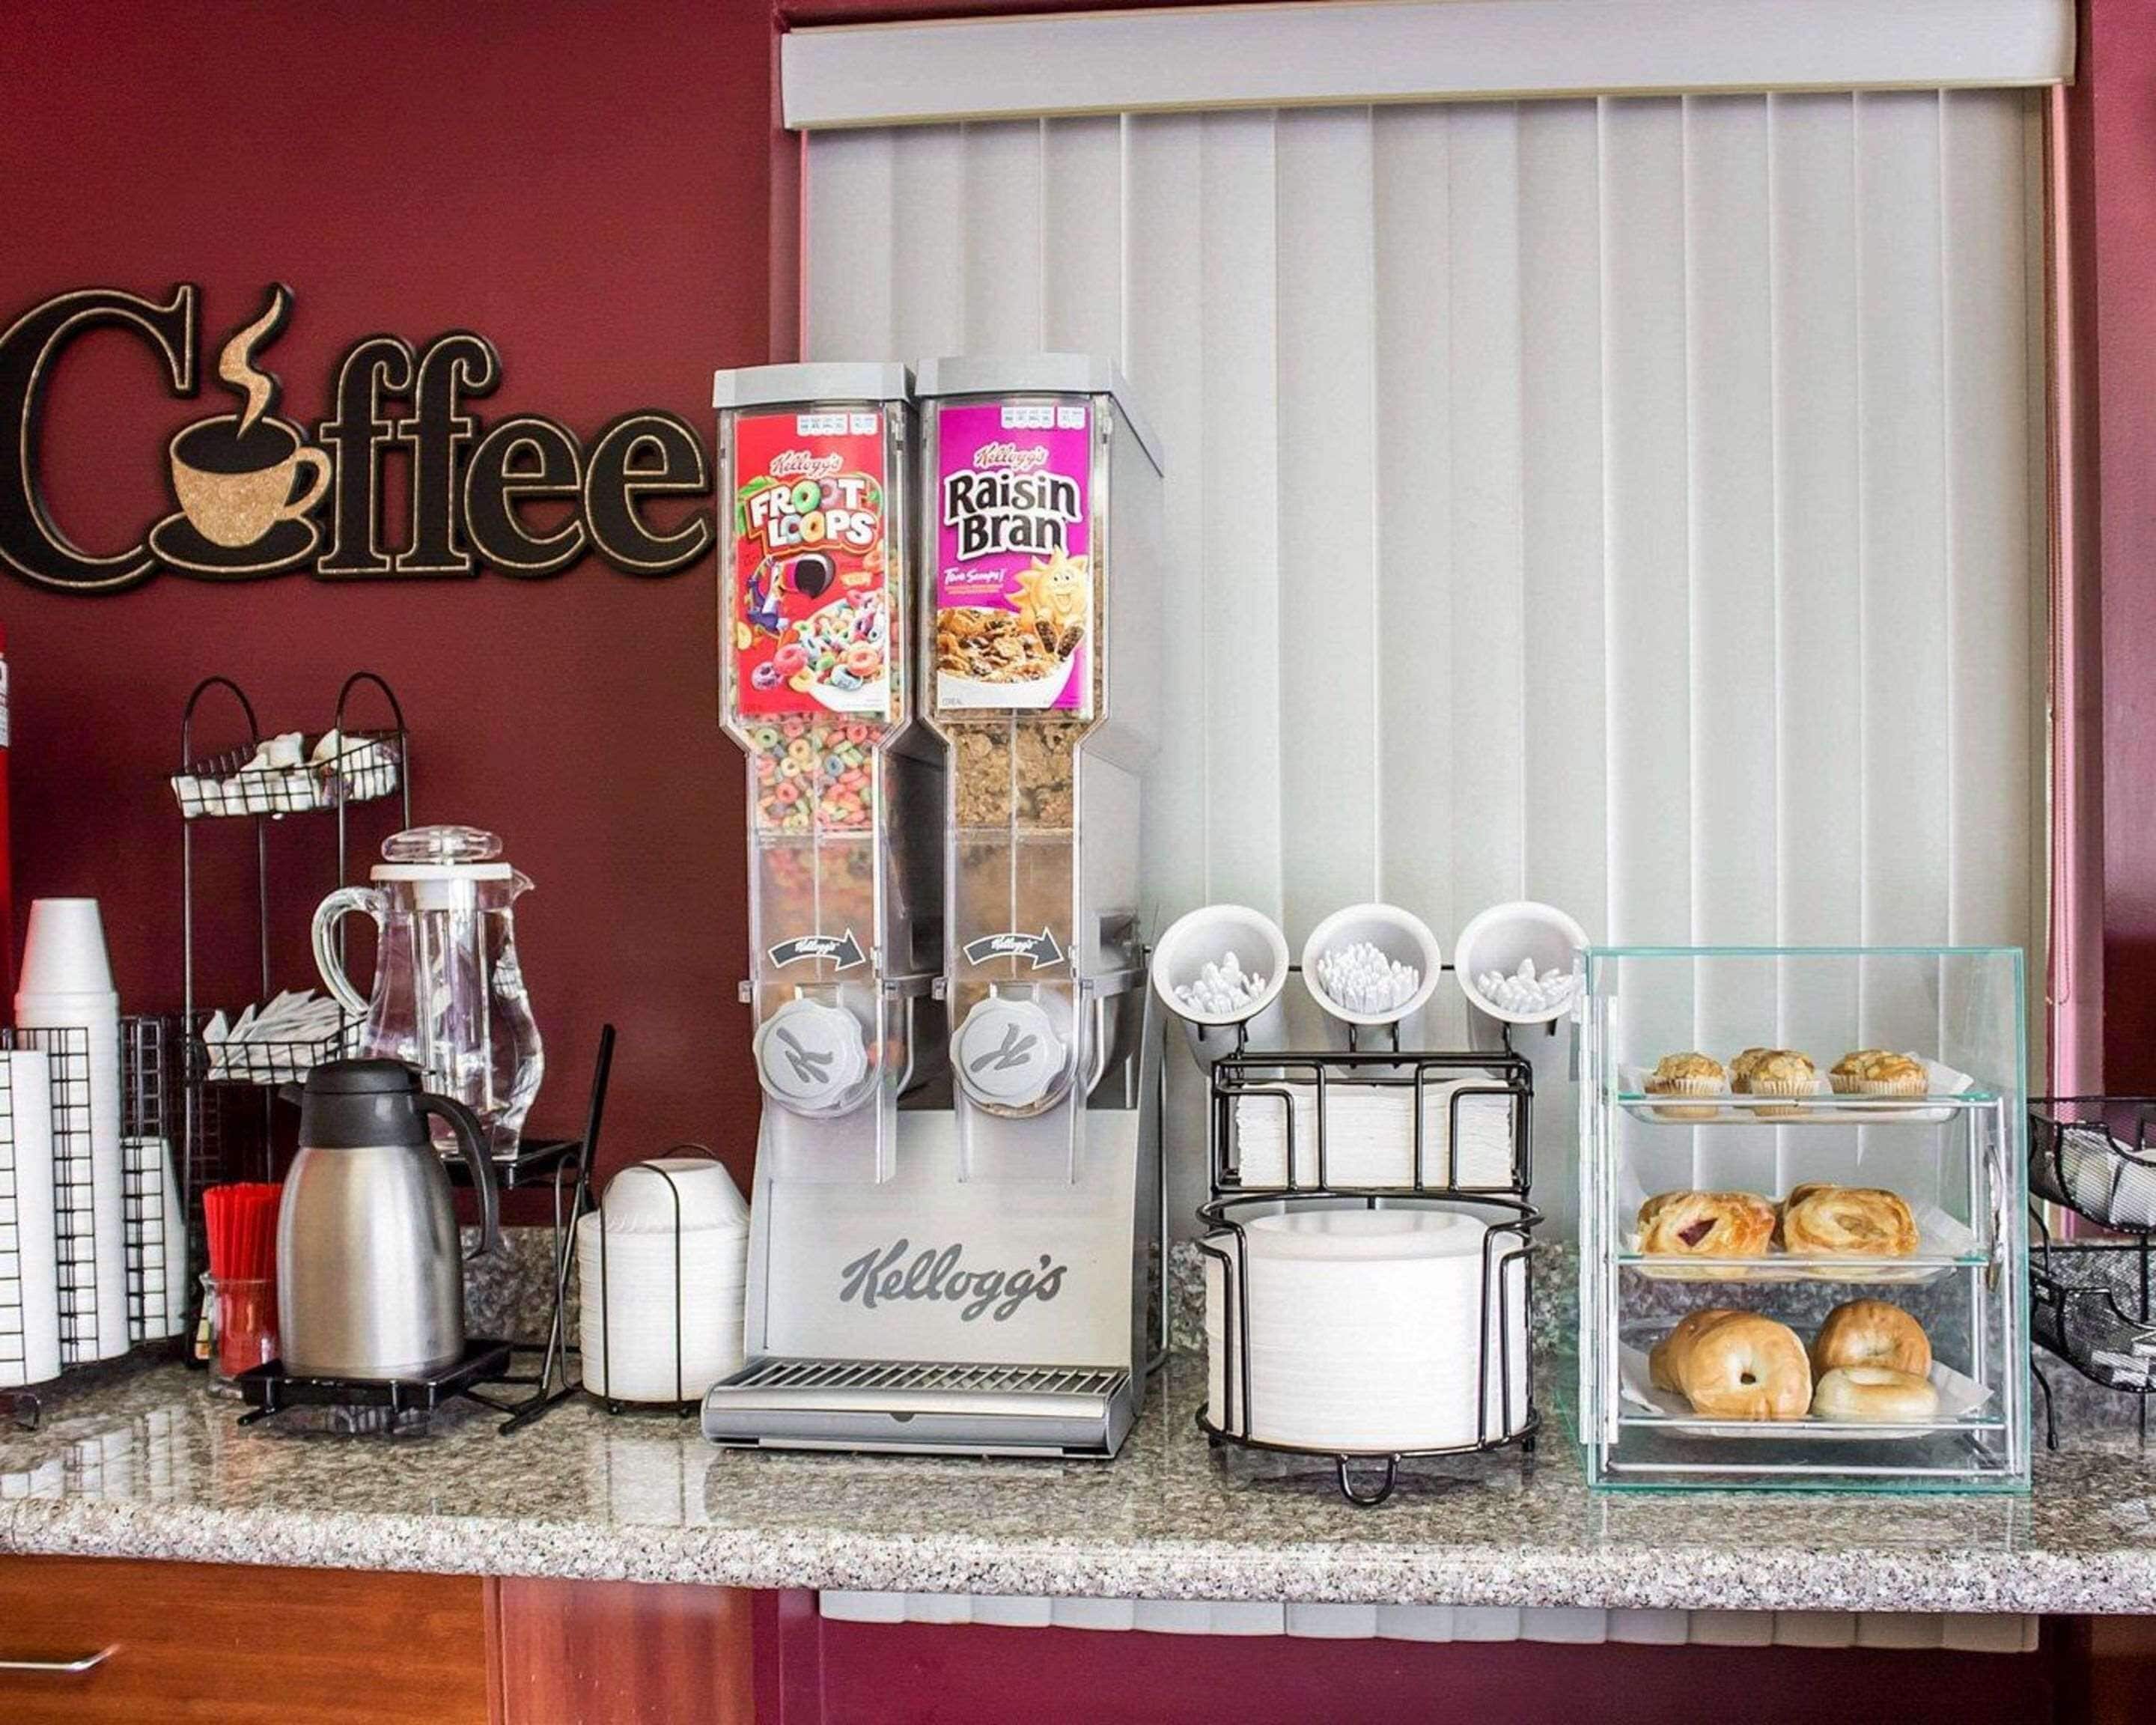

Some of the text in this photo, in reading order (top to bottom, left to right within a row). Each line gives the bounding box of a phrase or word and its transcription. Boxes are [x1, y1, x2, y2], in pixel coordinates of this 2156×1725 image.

[771, 451, 843, 478] Kellogg's
[975, 442, 1047, 470] Kellogg's
[750, 478, 865, 528] FROOT
[949, 473, 1077, 520] Raisin
[768, 510, 874, 547] LOOPS
[963, 514, 1063, 556] Bran
[839, 1238, 1068, 1321] Kellogg's
